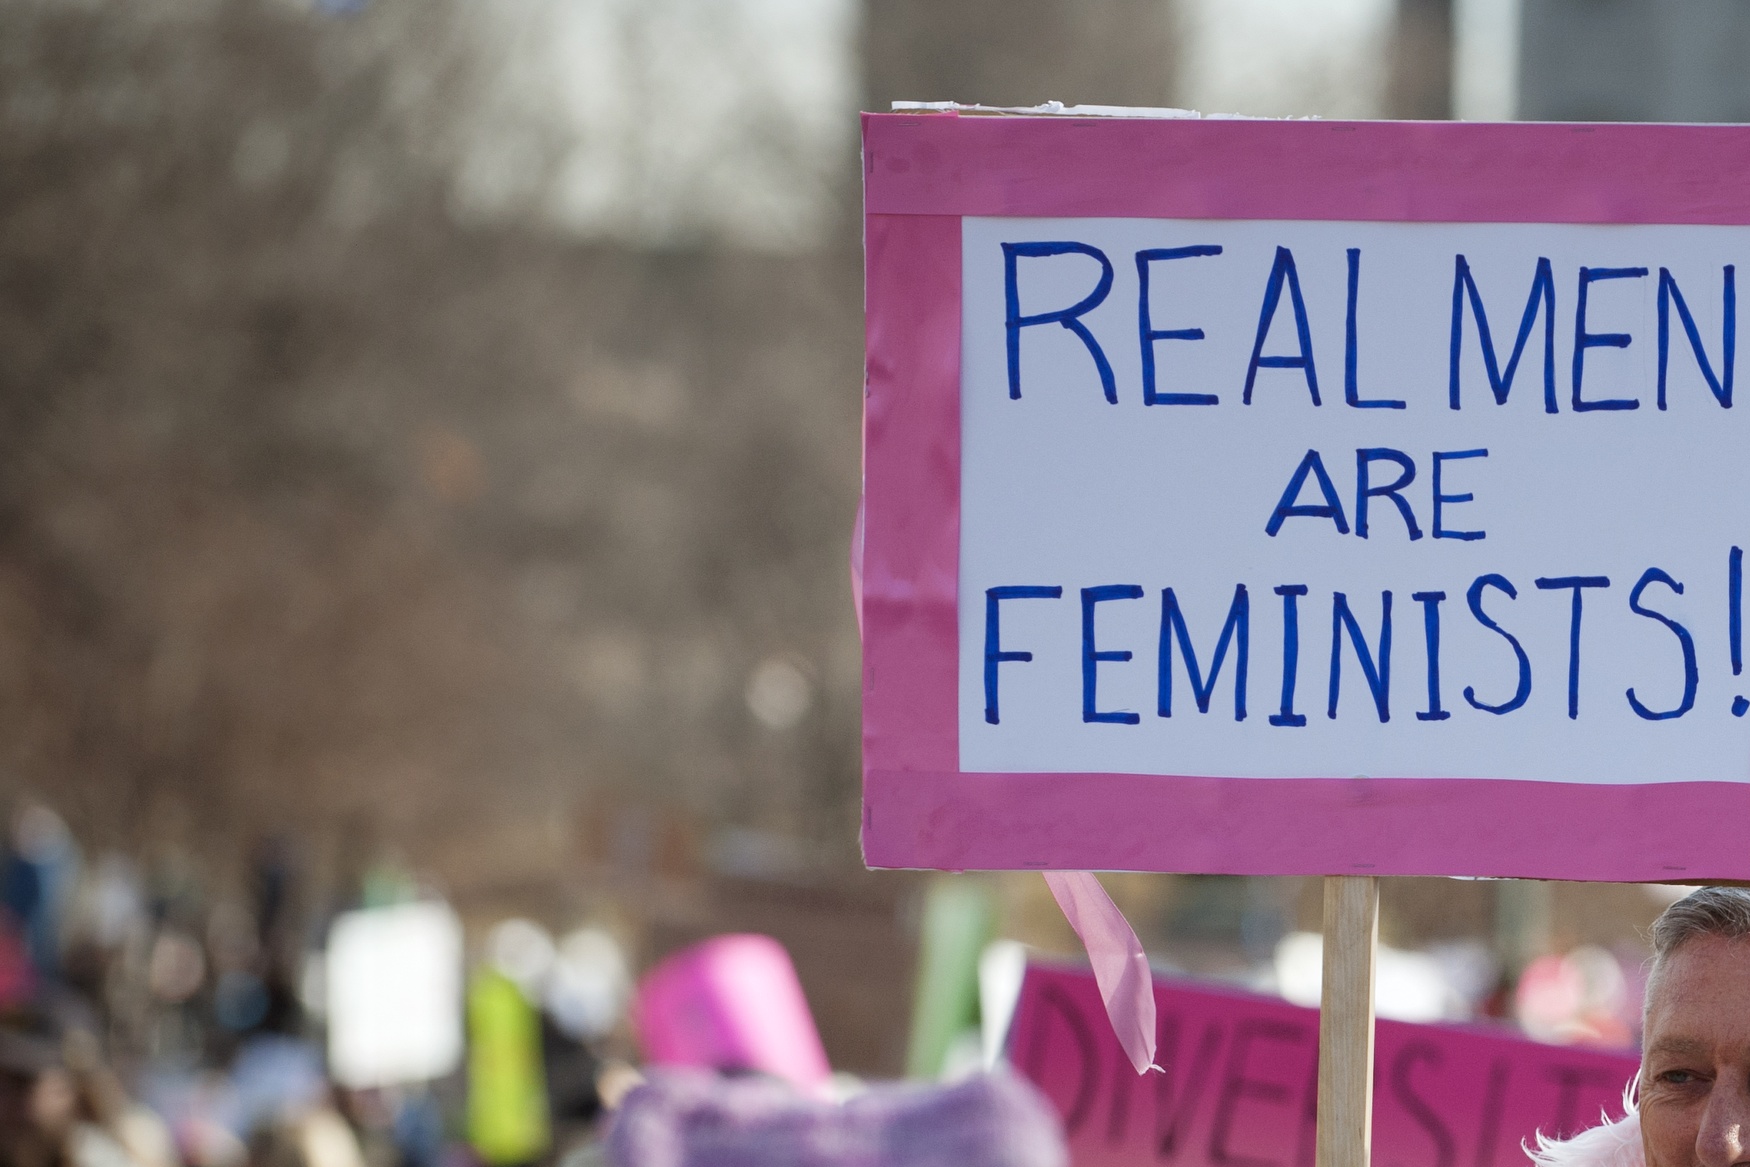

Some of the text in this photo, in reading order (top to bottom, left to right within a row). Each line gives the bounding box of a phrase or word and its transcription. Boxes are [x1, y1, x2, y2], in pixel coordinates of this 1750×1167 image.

[1000, 240, 1737, 415] REAL MEN
[1264, 446, 1490, 542] ARE
[983, 545, 1750, 728] FEMINISTS!
